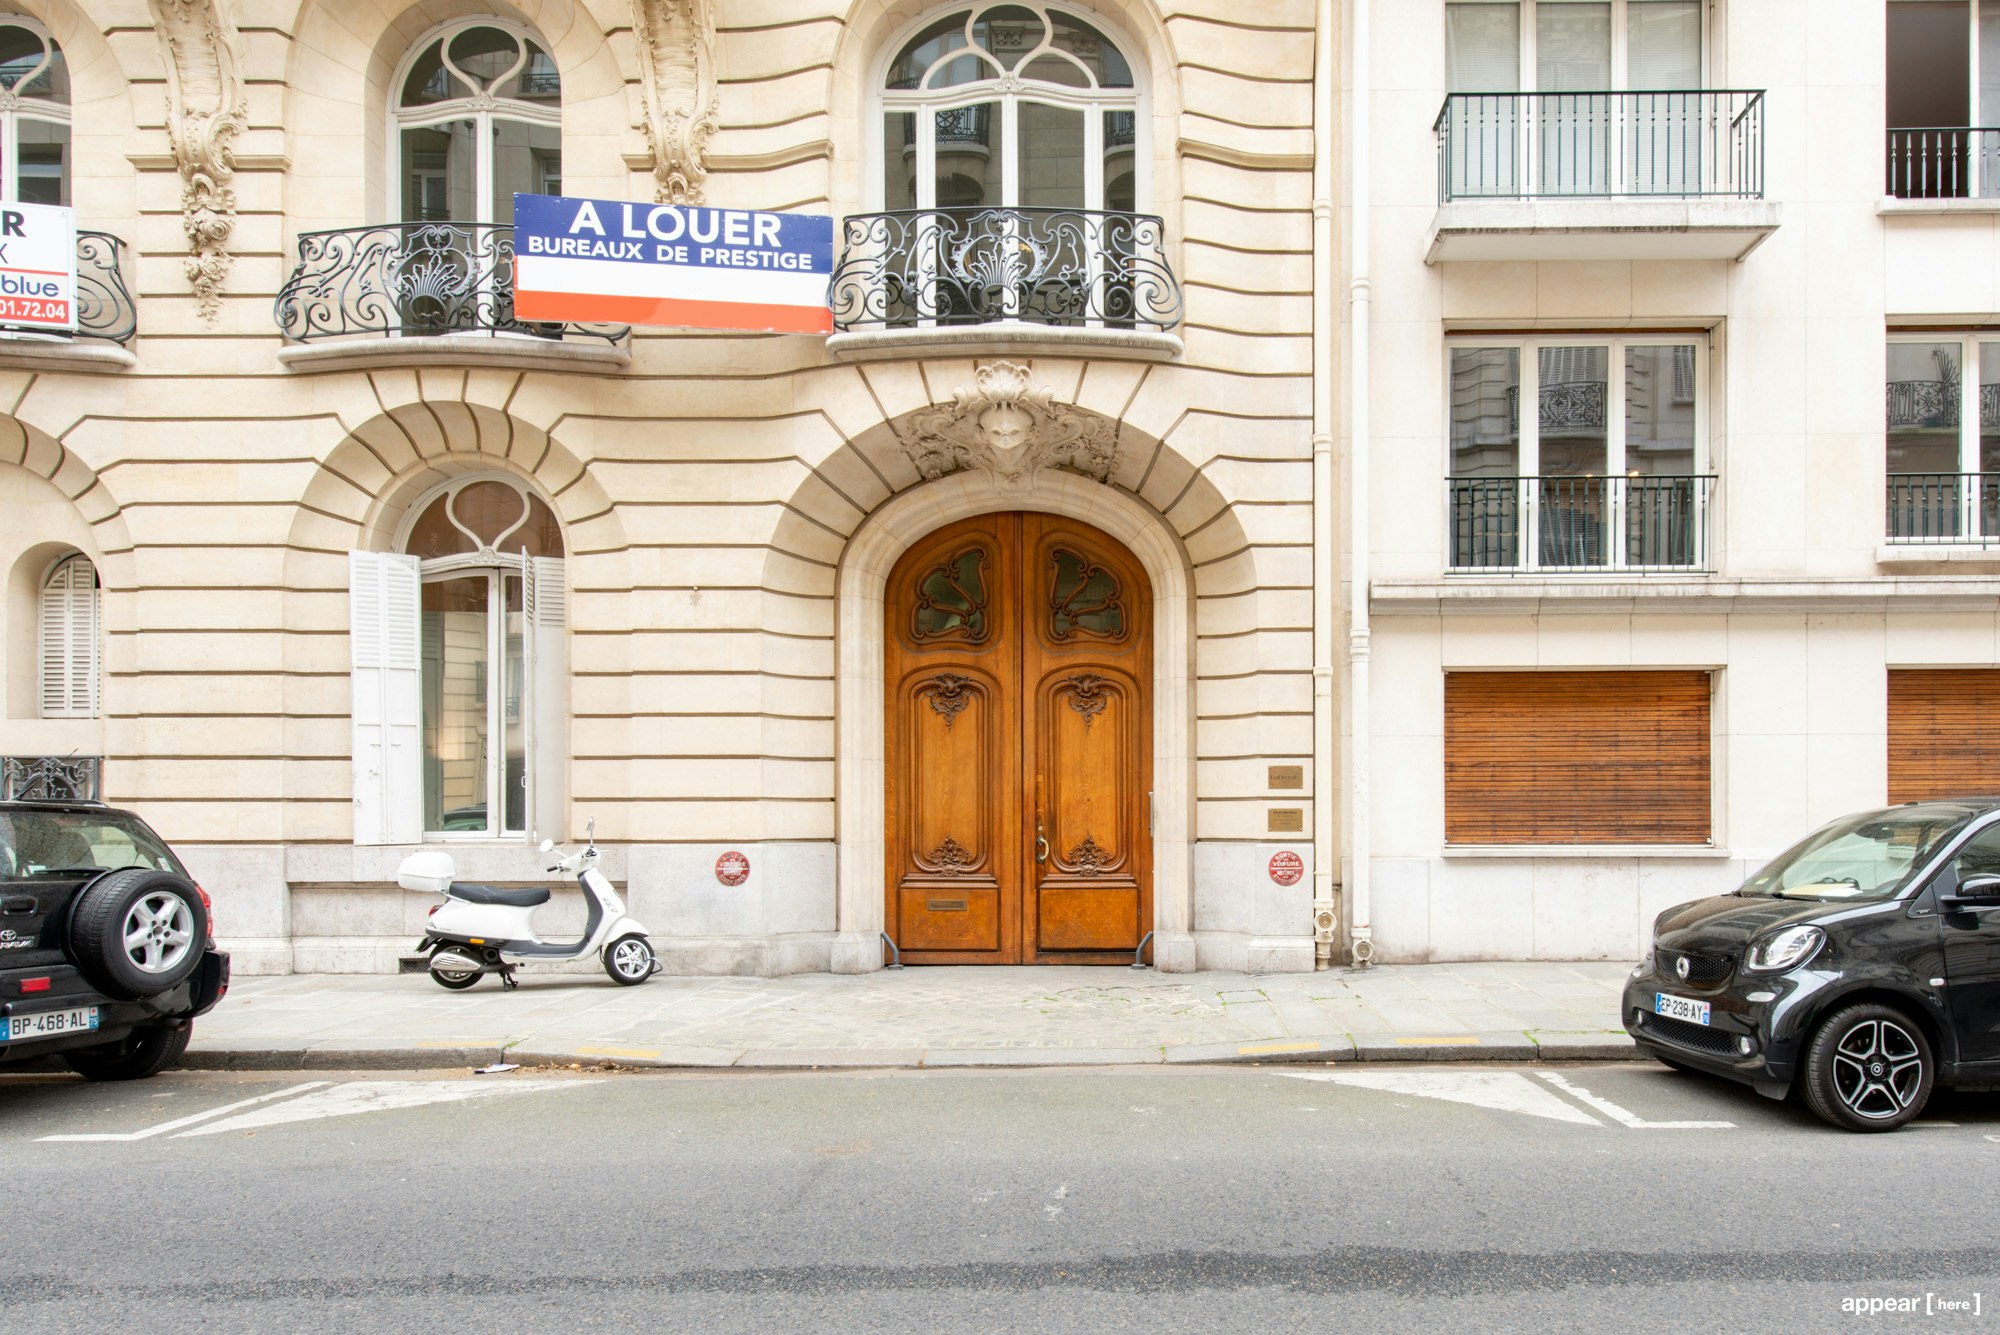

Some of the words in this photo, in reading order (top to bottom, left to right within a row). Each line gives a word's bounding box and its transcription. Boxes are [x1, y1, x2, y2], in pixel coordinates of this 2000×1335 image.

[568, 201, 606, 236] A
[622, 203, 782, 248] LOUER
[528, 236, 643, 260] BUREAUX
[656, 245, 689, 263] DE
[701, 248, 813, 271] PRESTIGE
[1, 274, 59, 297] blue
[12, 1011, 87, 1035] BP-468-AL
